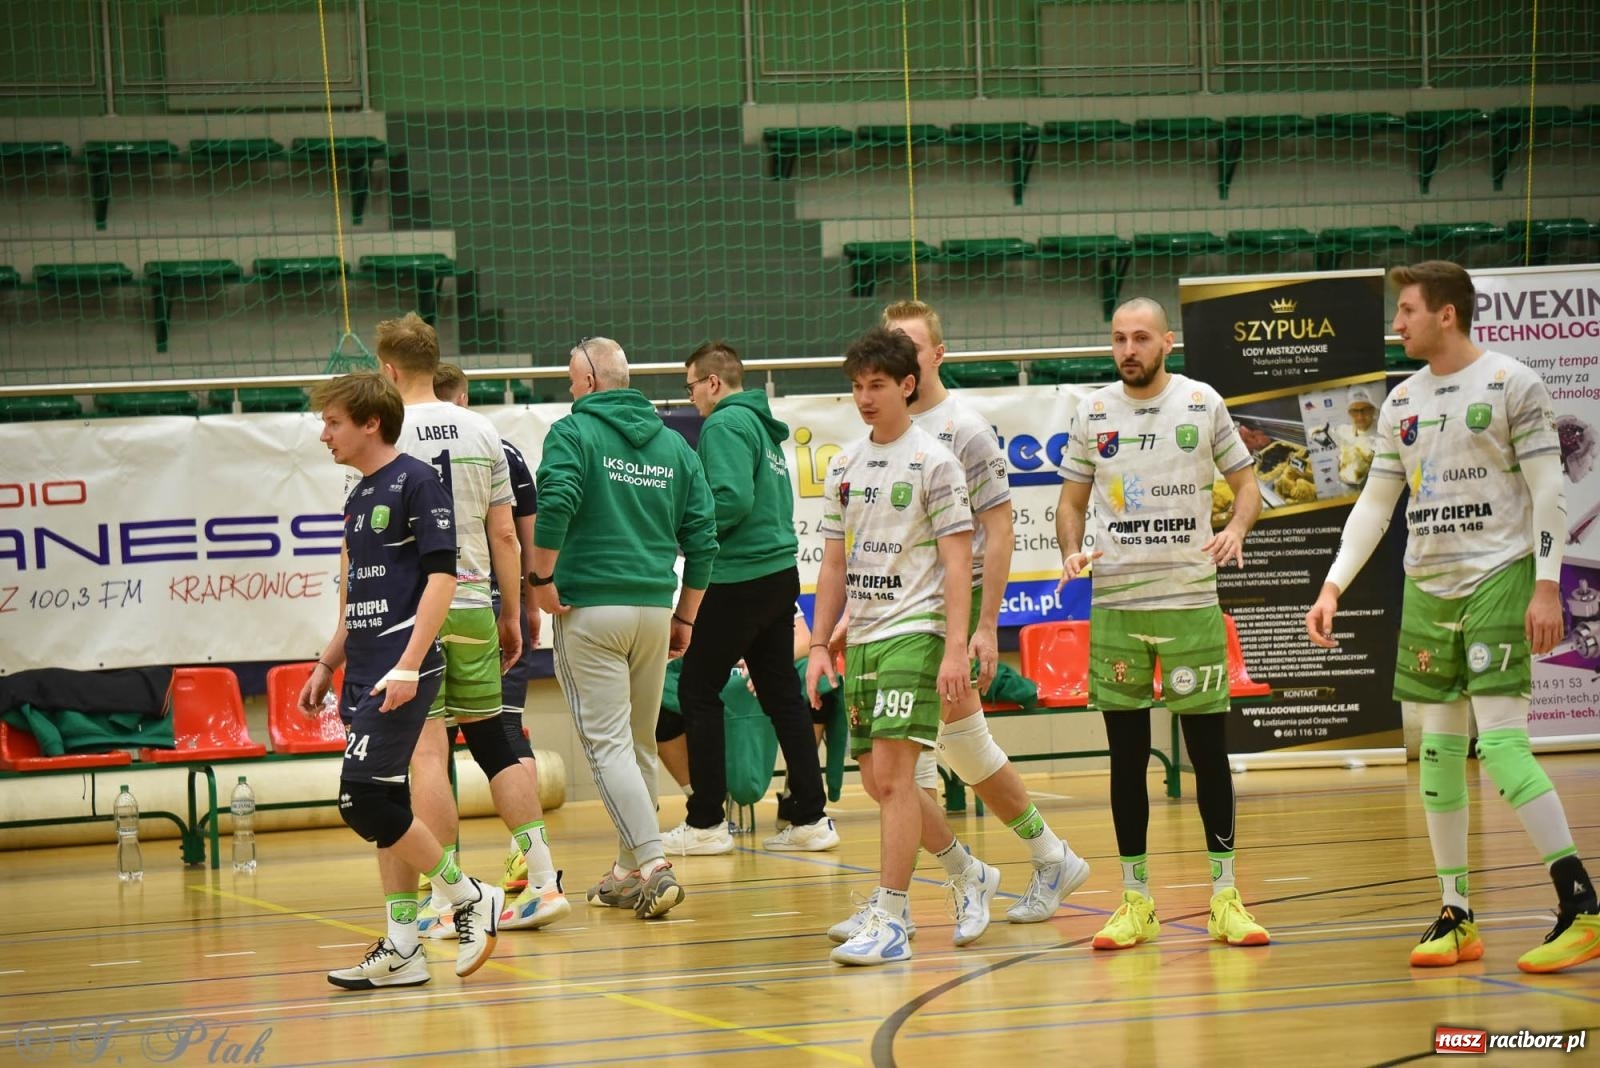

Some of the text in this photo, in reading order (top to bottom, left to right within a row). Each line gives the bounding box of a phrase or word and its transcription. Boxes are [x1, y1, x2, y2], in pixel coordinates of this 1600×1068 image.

[1234, 318, 1335, 342] SZYPUŁA
[1242, 345, 1328, 357] LODY MISTRZOWSKIE
[1253, 357, 1292, 366] Naturalnie
[1560, 356, 1598, 368] tempa
[1575, 373, 1589, 383] za
[1440, 414, 1447, 432] 7
[416, 425, 458, 441] LABER
[1138, 434, 1156, 450] 77
[603, 456, 674, 480] LKS OLIMPIA
[1442, 466, 1488, 482] GUARD
[608, 472, 667, 489] WŁODOWICE
[1151, 484, 1196, 497] GUARD
[1442, 503, 1492, 520] CIEPŁA
[354, 514, 365, 532] 24
[1108, 518, 1196, 534] POMPY CIEPŁA
[1433, 524, 1455, 534] 944
[1459, 522, 1484, 532] 146
[863, 541, 902, 554] GUARD
[1120, 535, 1190, 545] 605 944 146
[357, 565, 386, 580] GUARD
[863, 575, 902, 588] CIEPŁA
[30, 587, 90, 611] 100,3
[98, 578, 142, 609] FM
[169, 571, 328, 604] KRAPKOWICE
[357, 599, 388, 616] CIEPŁA
[352, 619, 367, 629] 944
[368, 617, 382, 628] 146
[1499, 644, 1512, 672] 7
[1199, 665, 1223, 693] 77
[1552, 679, 1564, 689] 91
[1569, 677, 1582, 688] 53
[1284, 690, 1317, 698] KONTAKT
[885, 690, 913, 718] 99
[1242, 704, 1359, 716] WWW.LODOWEINSPIRACJE.ME
[1298, 718, 1311, 727] pod
[345, 732, 371, 761] 24
